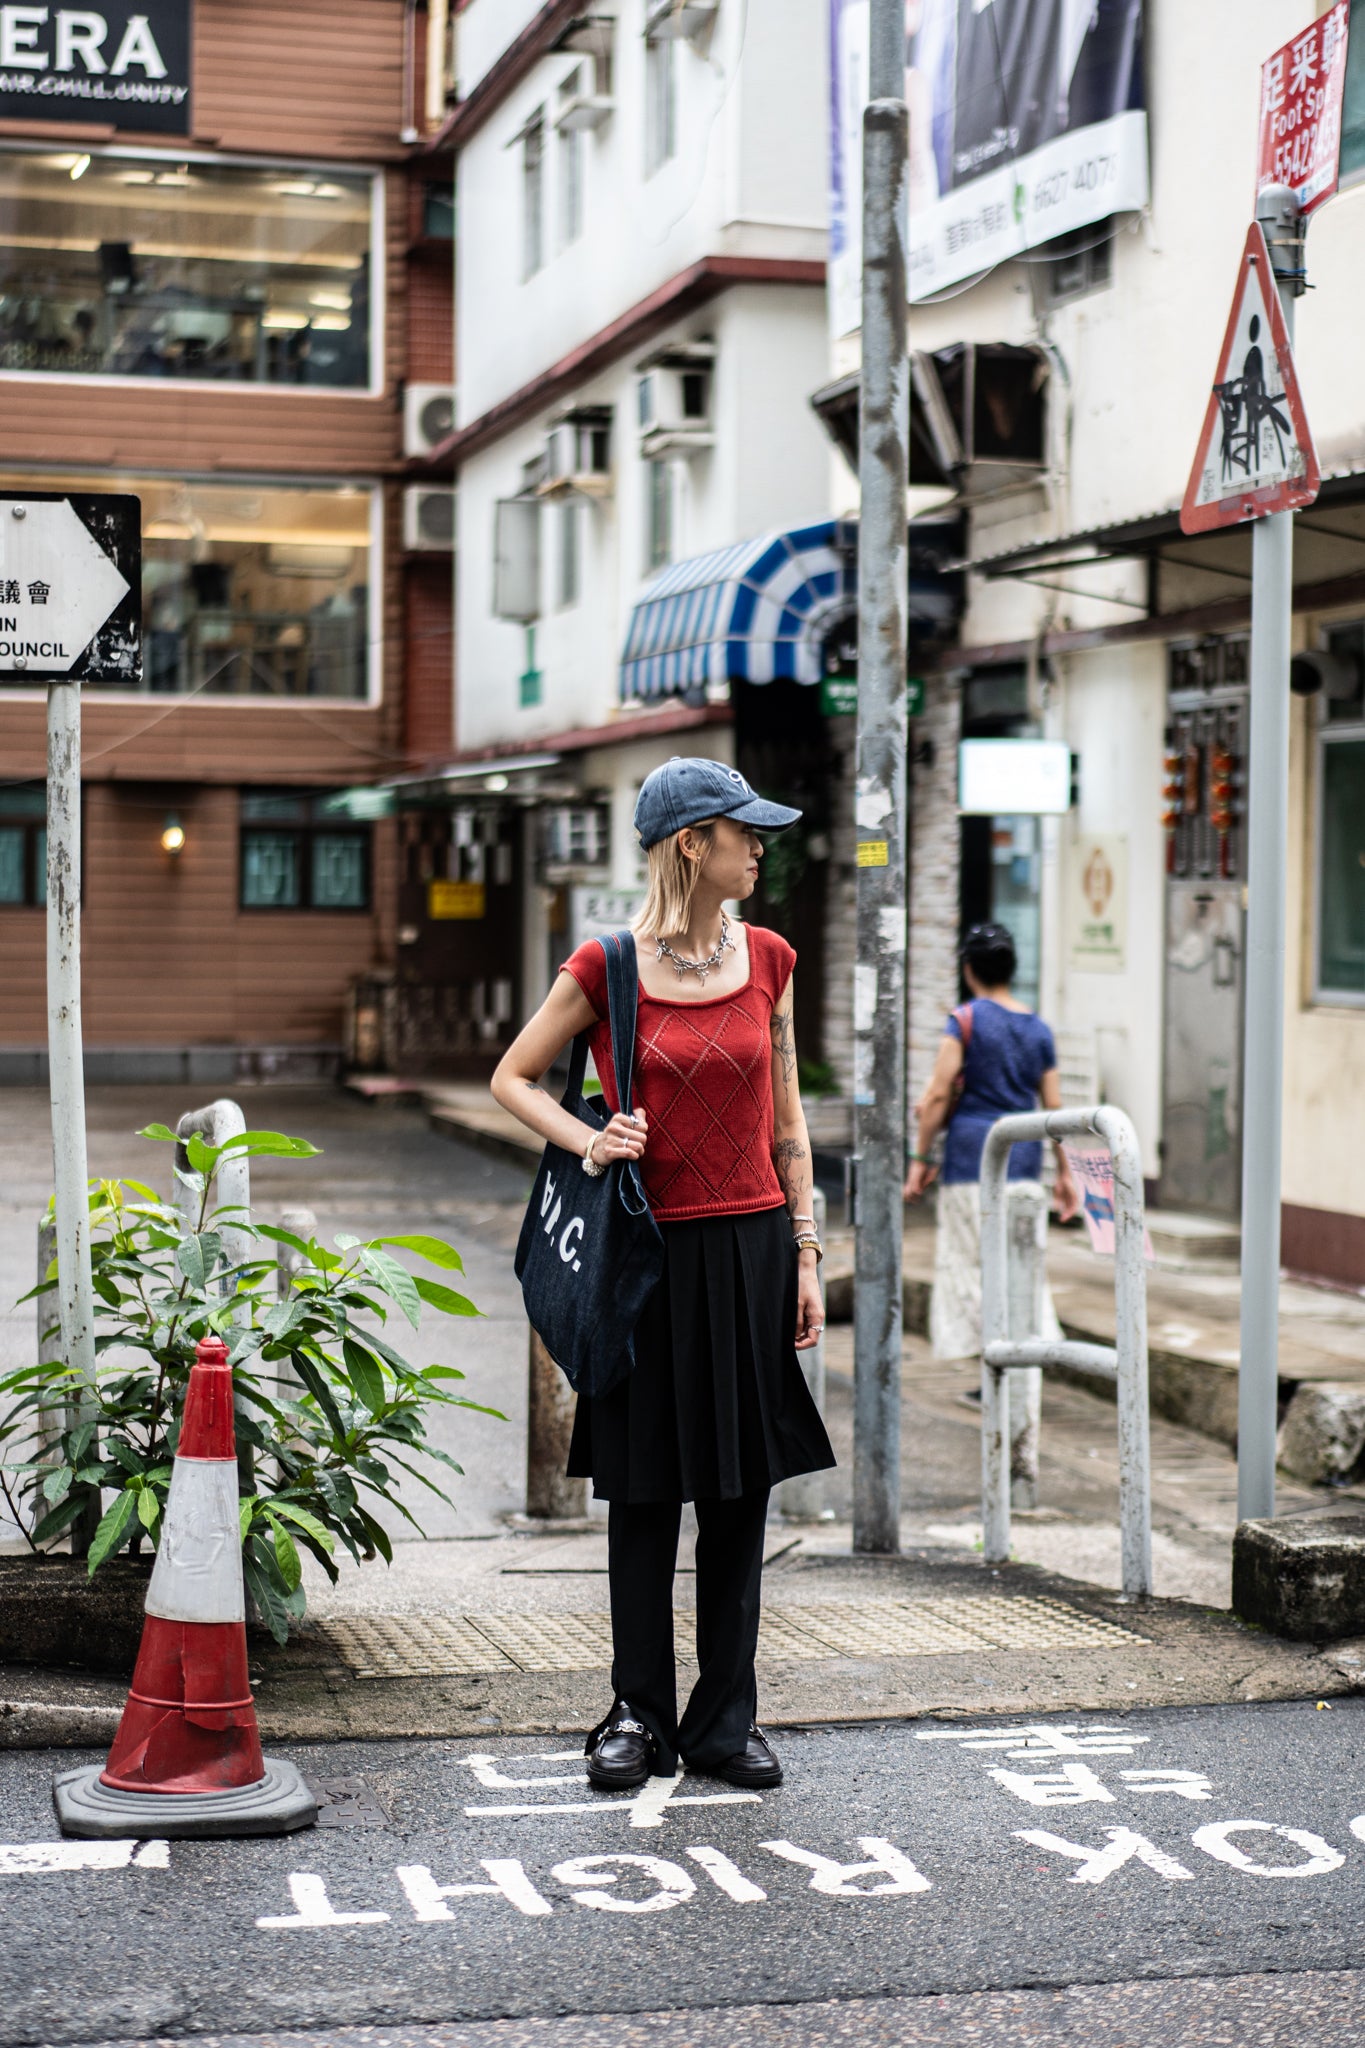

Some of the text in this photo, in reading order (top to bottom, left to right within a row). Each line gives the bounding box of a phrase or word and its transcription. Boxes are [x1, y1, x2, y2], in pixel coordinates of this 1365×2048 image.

[0, 4, 168, 79] ERA
[1269, 97, 1303, 144] Foot
[0, 579, 51, 605] 議會
[0, 641, 70, 657] OUNCIL
[255, 1815, 1365, 1929] OK RIGHT
